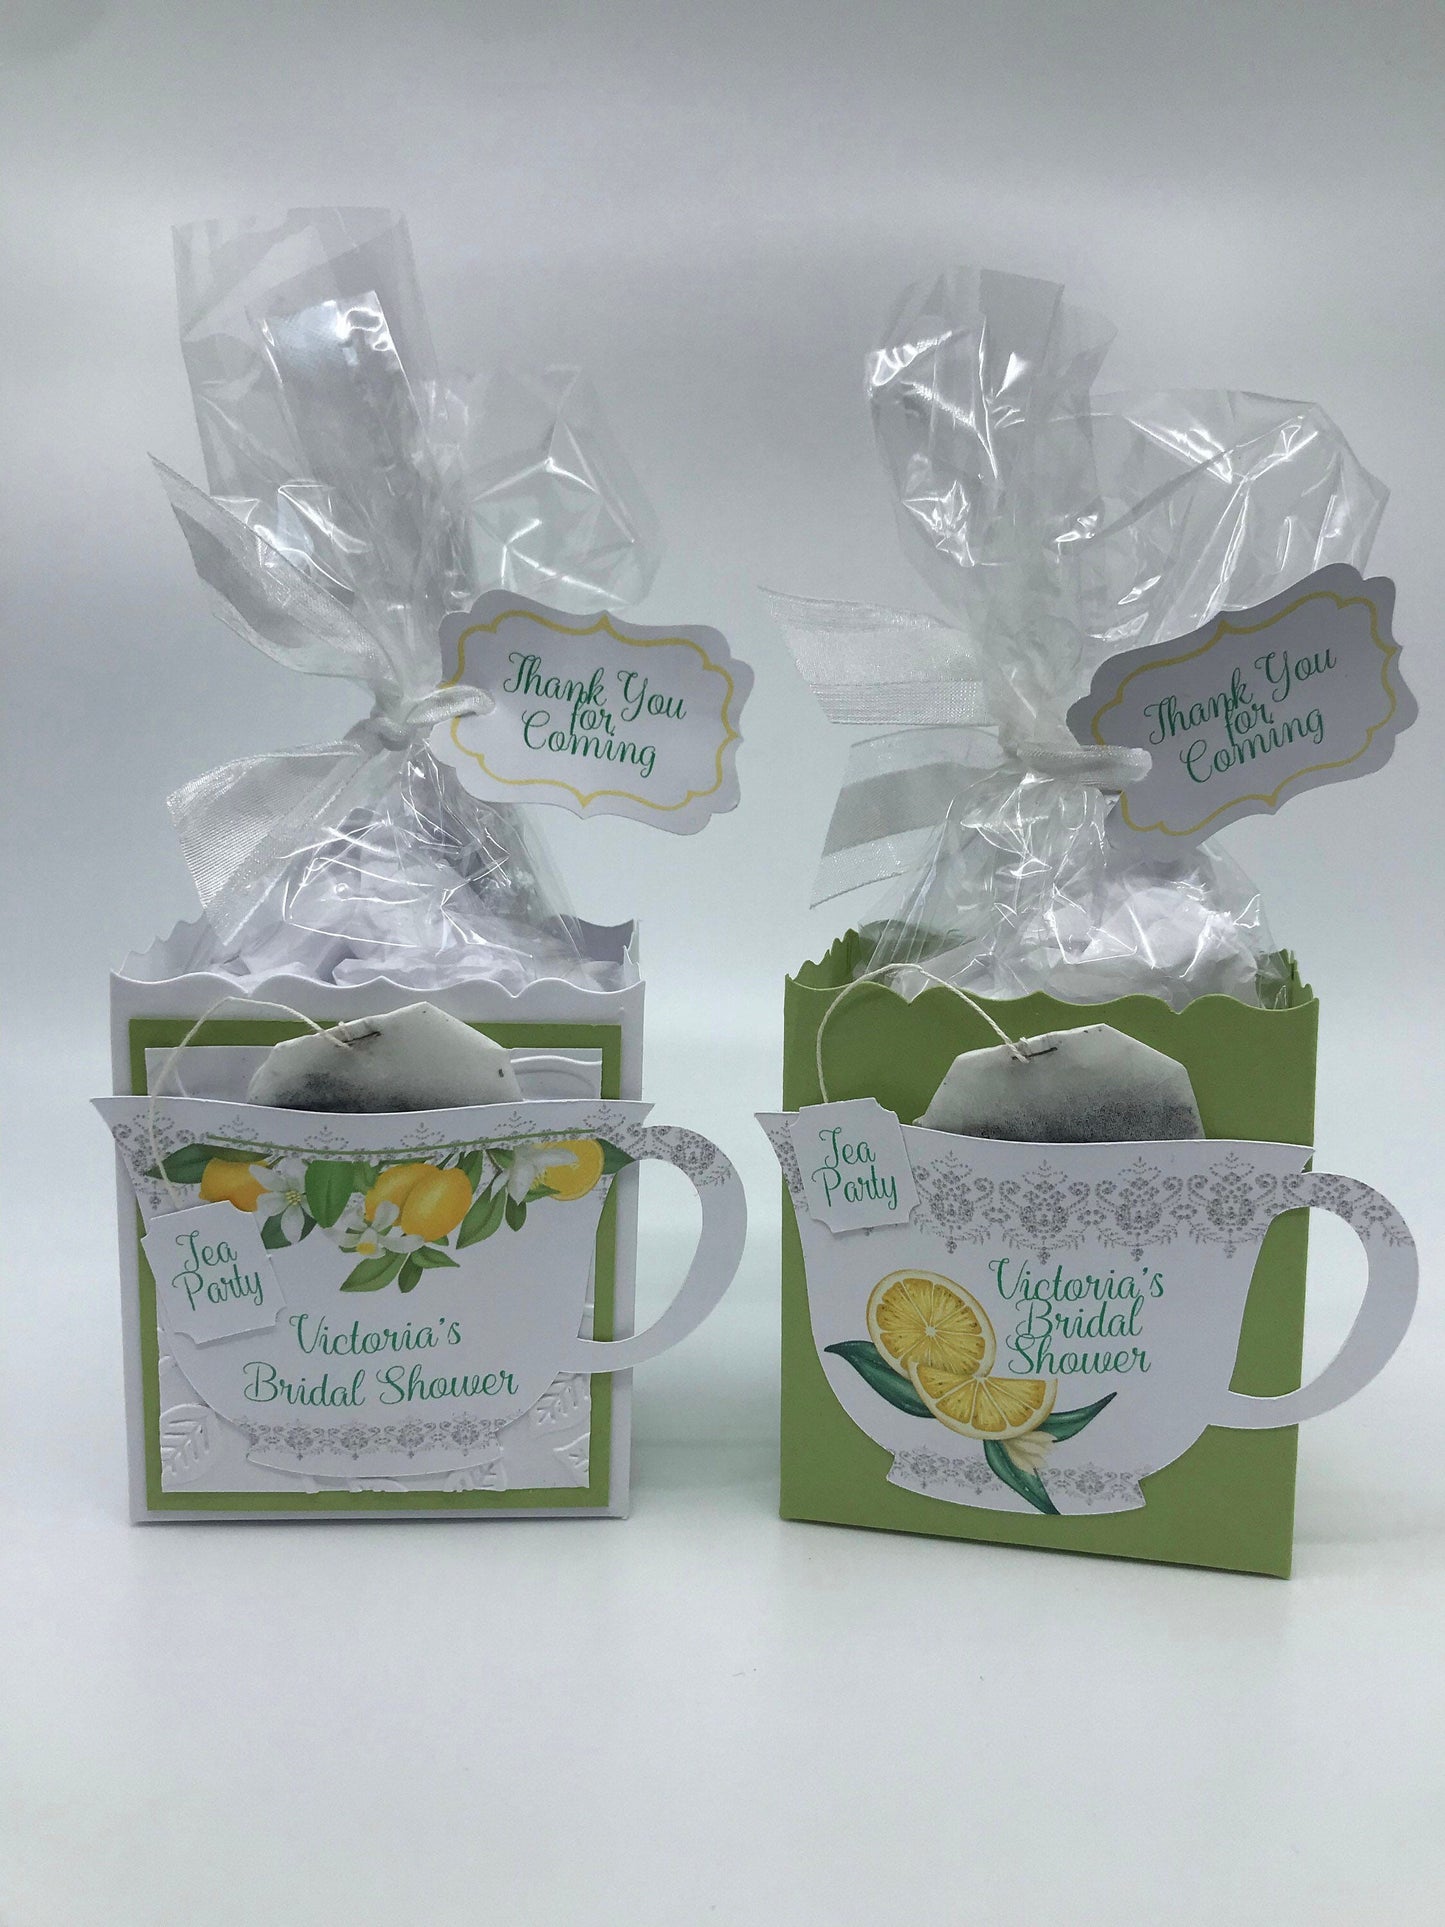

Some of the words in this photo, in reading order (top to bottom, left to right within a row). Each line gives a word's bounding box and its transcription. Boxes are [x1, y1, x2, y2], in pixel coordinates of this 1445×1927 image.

[503, 651, 607, 706] Thank
[617, 669, 687, 722] You
[1143, 667, 1253, 745] Thank
[1254, 648, 1337, 702] You
[569, 690, 615, 736] for
[1225, 698, 1275, 747] for
[521, 708, 657, 778] Coming
[1179, 708, 1325, 783] Coming
[818, 1127, 876, 1170] Tea
[811, 1165, 899, 1210] Party
[175, 1230, 238, 1272] Tea
[171, 1264, 264, 1311] Party
[988, 1257, 1165, 1301] Victoria's
[289, 1313, 463, 1356] Victoria's
[1015, 1294, 1145, 1339] Bridal
[1006, 1332, 1151, 1375] Shower
[242, 1360, 366, 1408] Bridal
[375, 1364, 520, 1404] Shower
